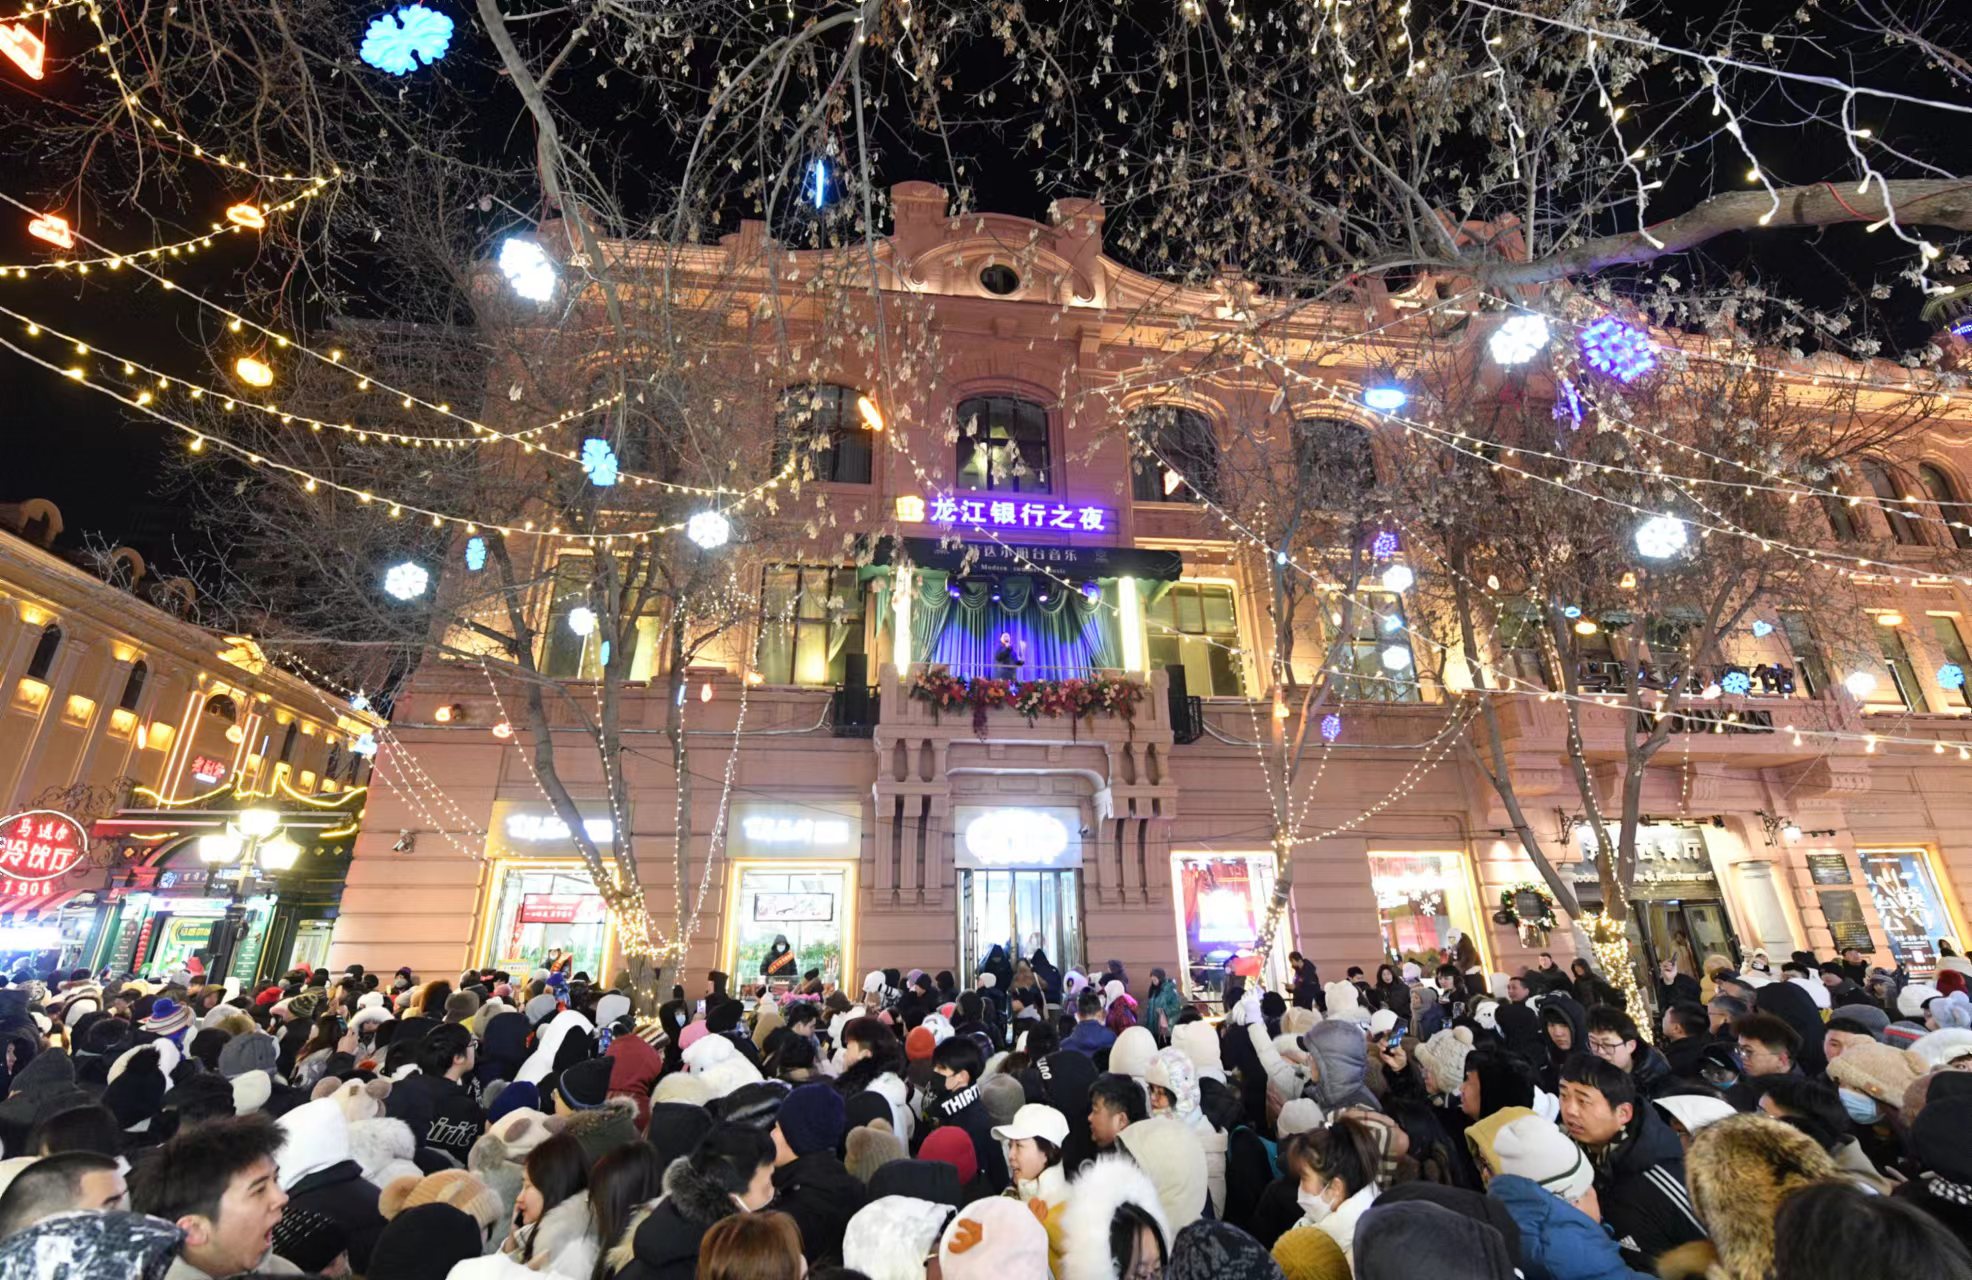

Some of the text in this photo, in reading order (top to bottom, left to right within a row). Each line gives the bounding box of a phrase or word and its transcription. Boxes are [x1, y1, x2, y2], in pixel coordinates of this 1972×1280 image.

[931, 498, 1105, 531] 龙江银行之夜
[967, 544, 1077, 562] 迭尔阳台音乐
[0, 839, 74, 872] 冷饮厅
[3, 880, 51, 897] 1906
[941, 1083, 981, 1116] THIRT
